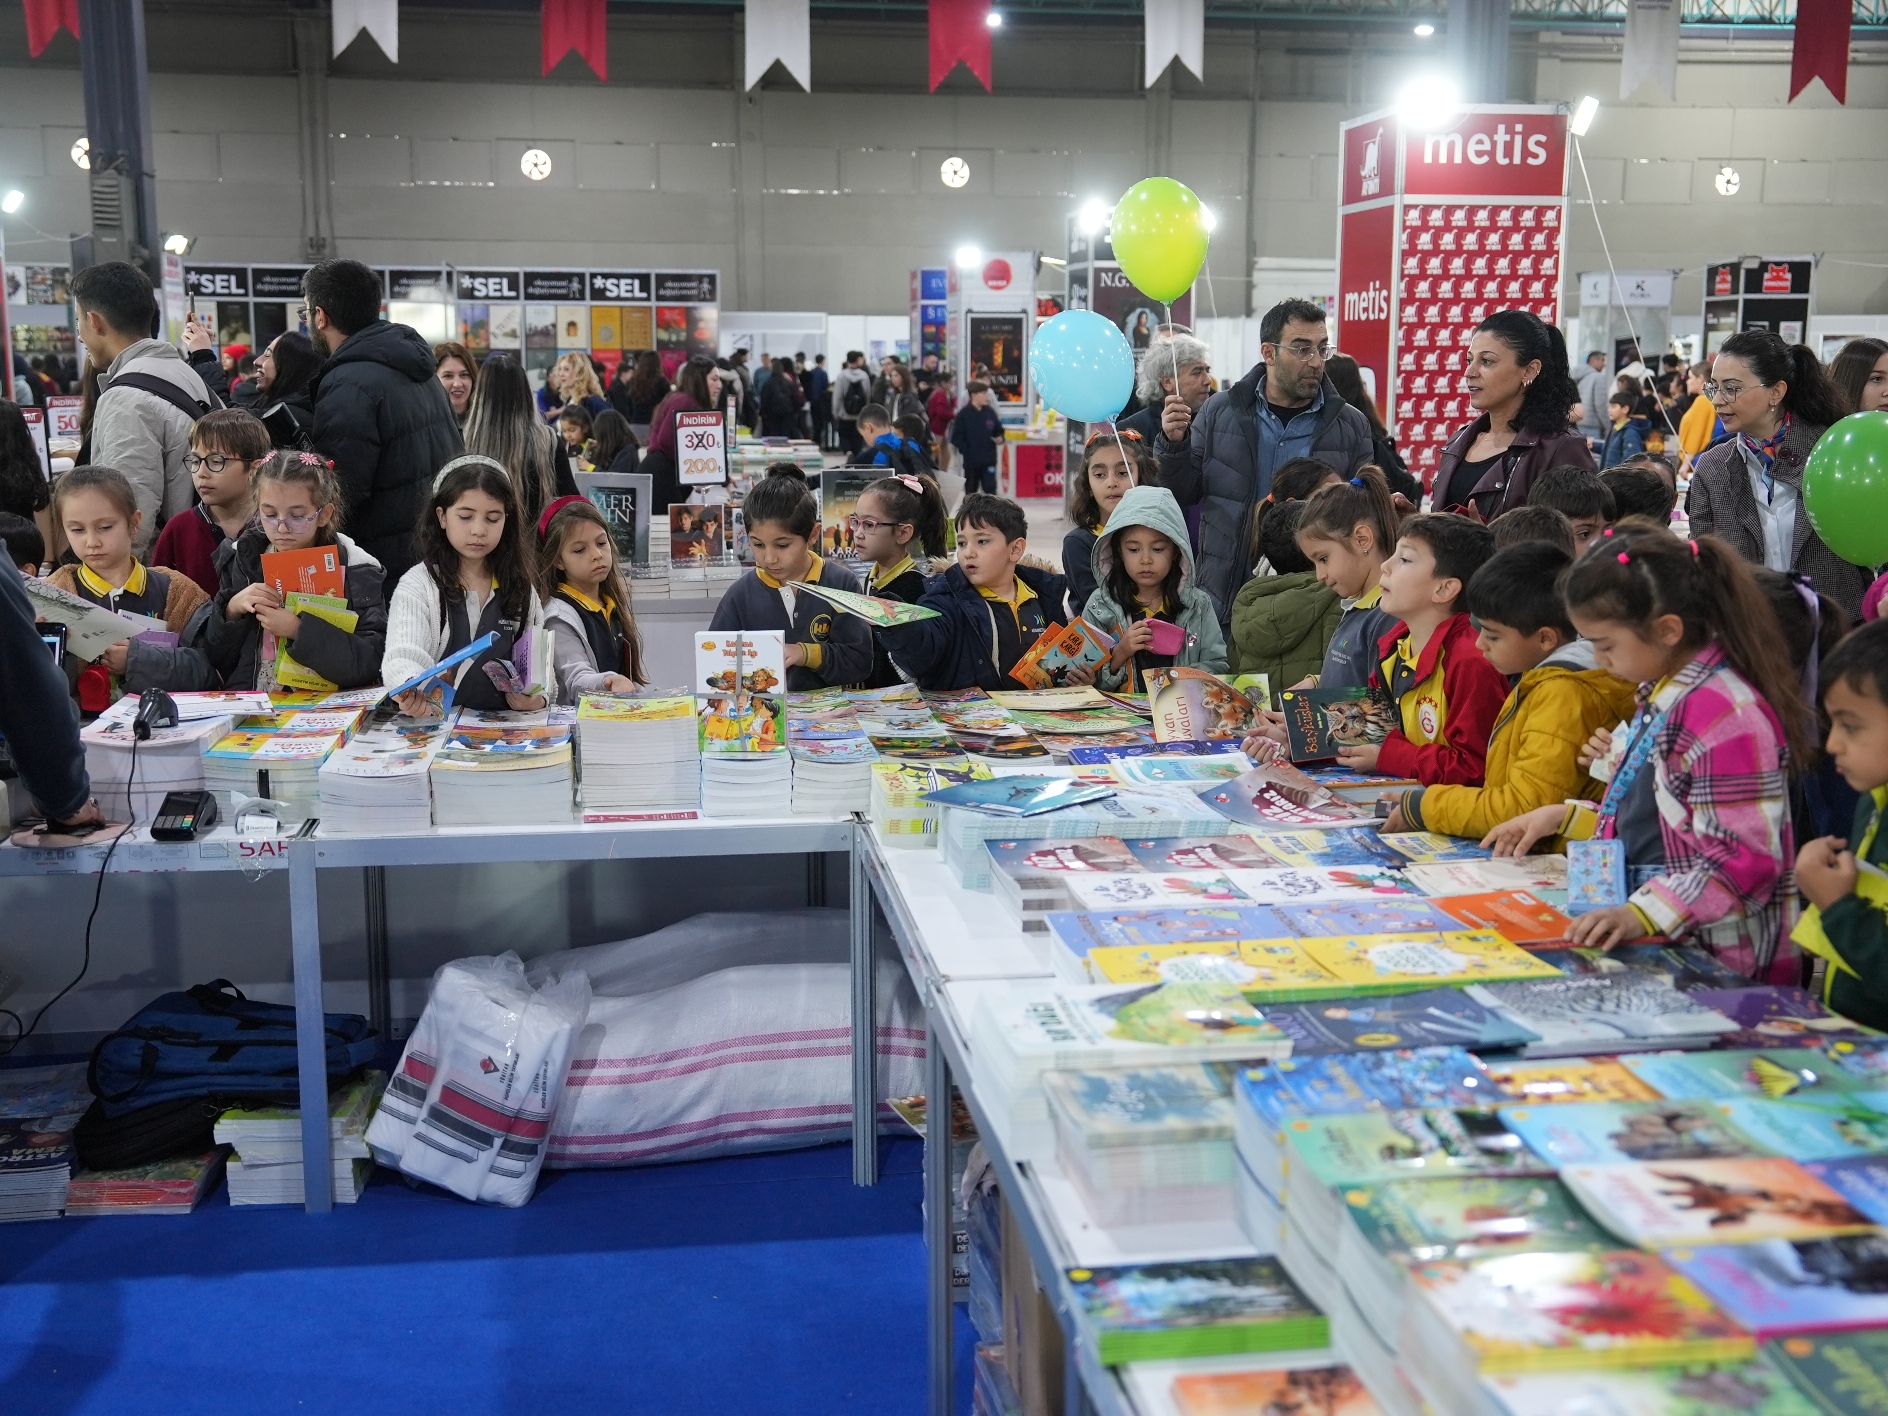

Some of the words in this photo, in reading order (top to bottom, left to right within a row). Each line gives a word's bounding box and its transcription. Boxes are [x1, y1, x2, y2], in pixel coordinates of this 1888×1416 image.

[1423, 124, 1548, 166] metis
[1344, 280, 1389, 321] metis
[683, 415, 717, 425] İNDİRİM
[1164, 713, 1181, 741] yvan
[1176, 696, 1192, 740] uvaları
[1295, 695, 1319, 754] Baykuşlar
